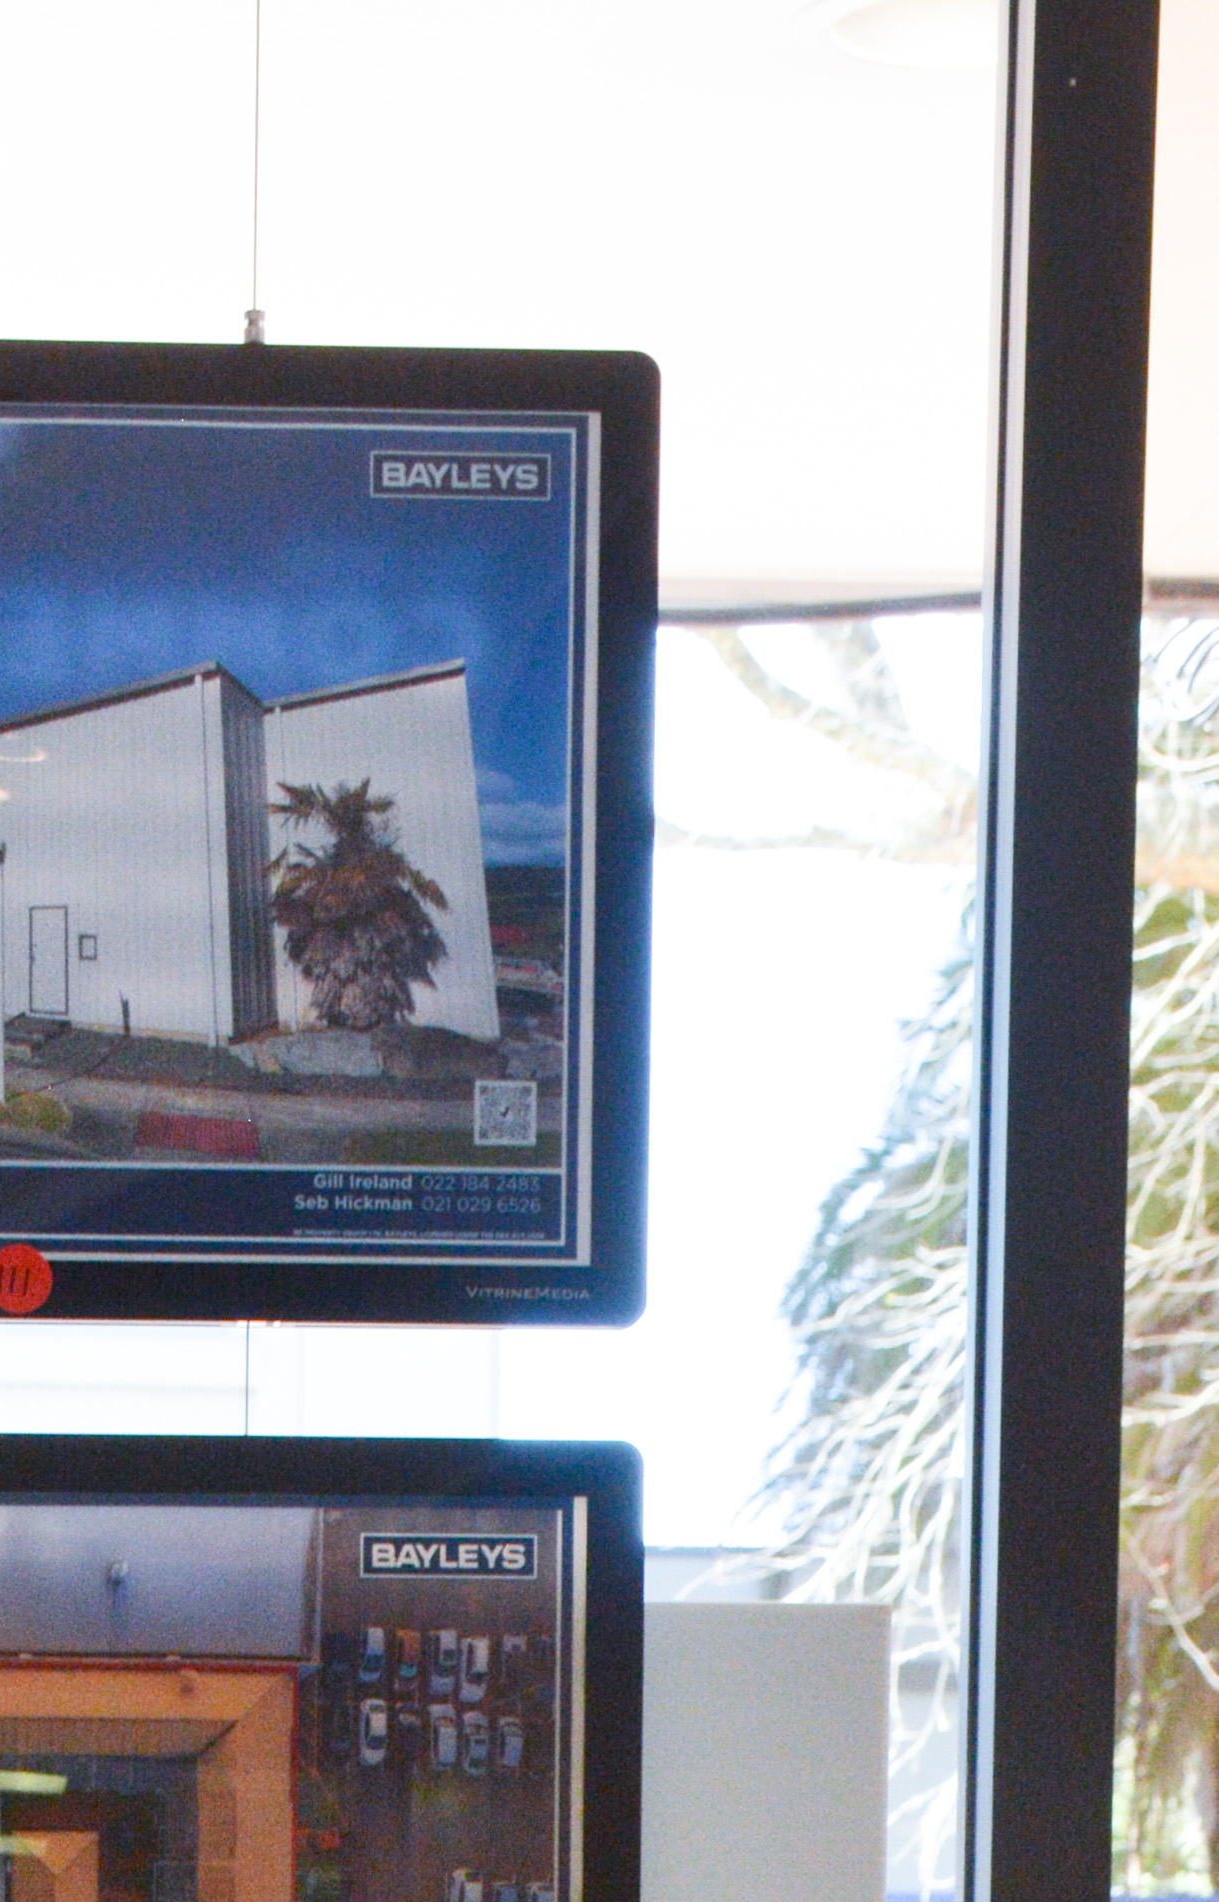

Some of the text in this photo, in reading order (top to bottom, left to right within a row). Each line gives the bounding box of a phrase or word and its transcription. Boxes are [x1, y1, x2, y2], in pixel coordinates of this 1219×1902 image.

[382, 462, 539, 490] BAYLEYS
[313, 1174, 541, 1192] Gill Ireland 022 184 2483
[294, 1194, 329, 1211] Seb
[335, 1195, 413, 1211] Hickman
[421, 1197, 450, 1212] 021
[456, 1197, 491, 1213] 029
[372, 1543, 526, 1569] BAYLEYS
